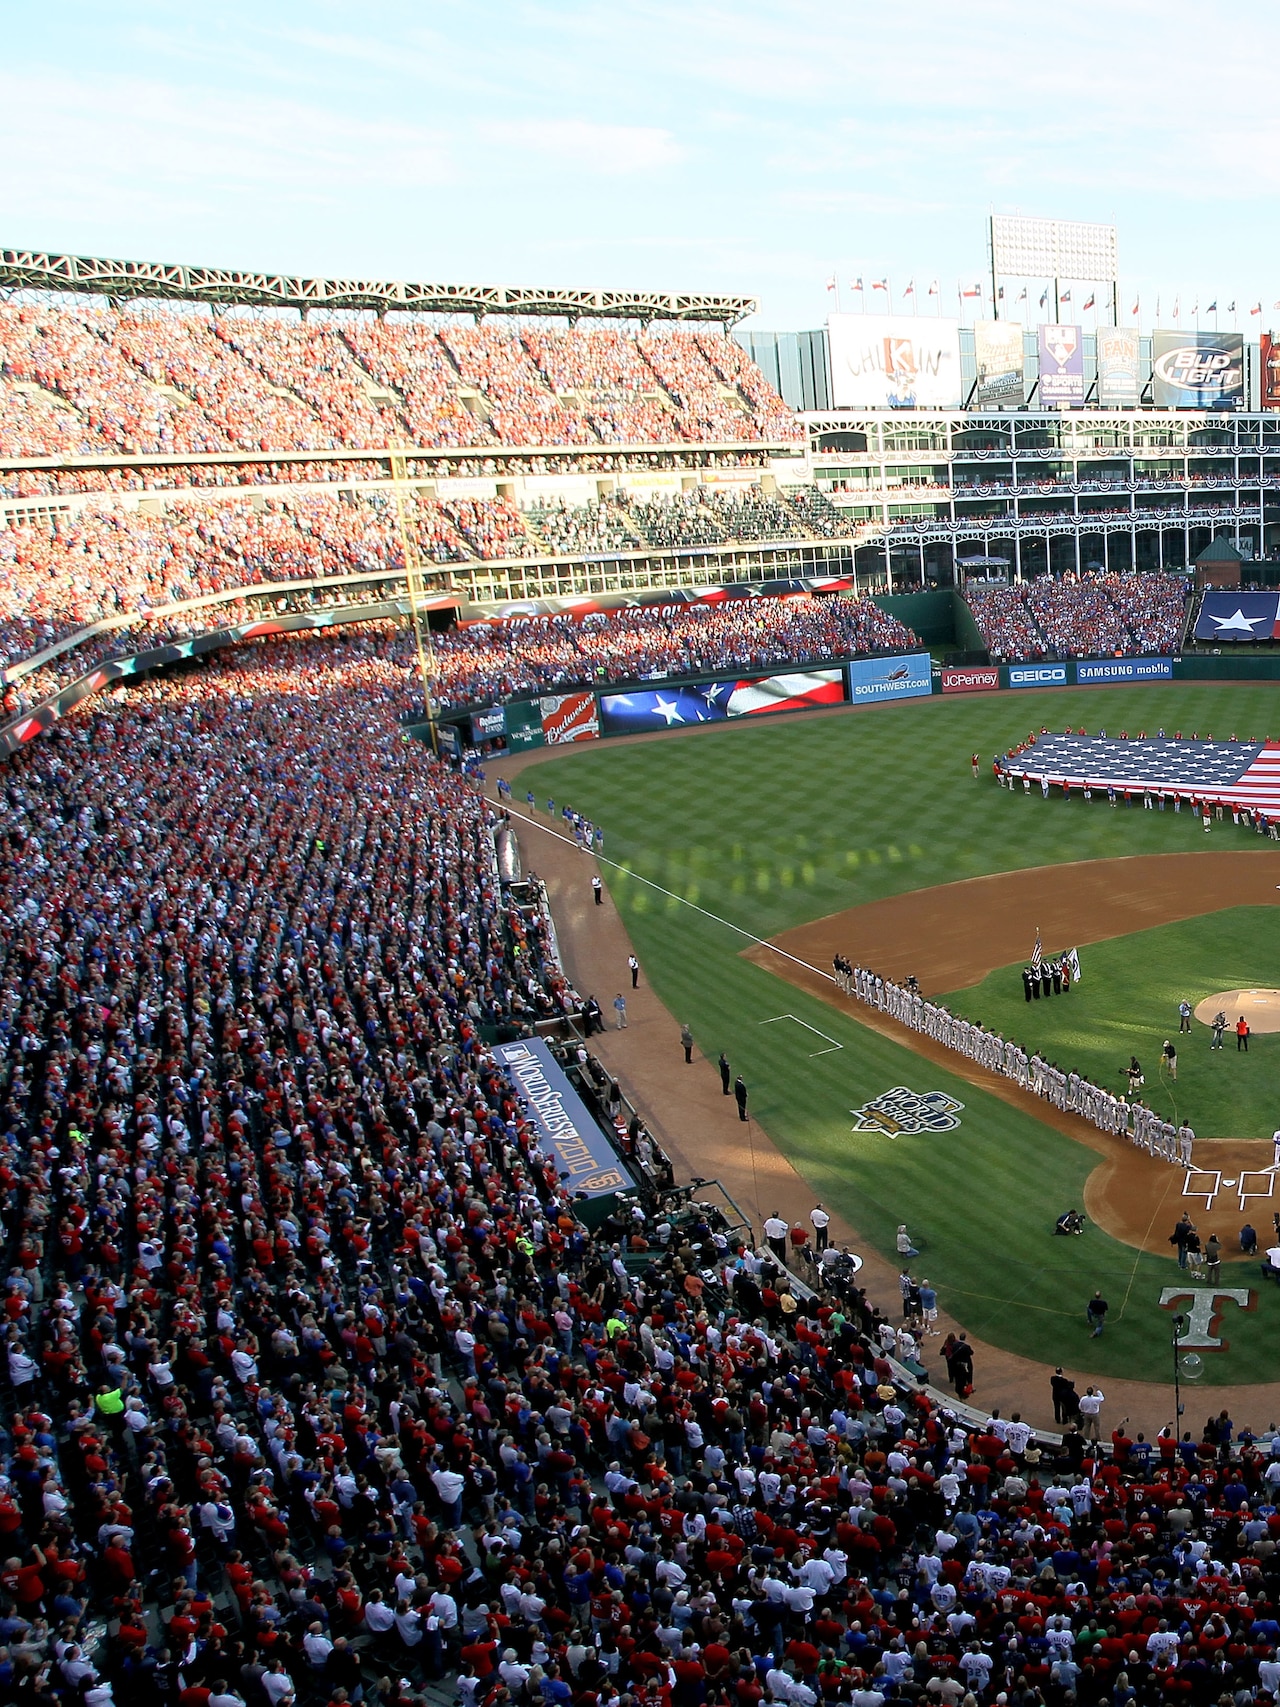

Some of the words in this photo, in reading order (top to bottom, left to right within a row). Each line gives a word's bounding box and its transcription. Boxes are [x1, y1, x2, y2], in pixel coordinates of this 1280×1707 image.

[1103, 340, 1135, 358] FAN
[1175, 352, 1231, 369] BUD
[1165, 366, 1240, 385] LIGHT
[943, 674, 997, 687] JCPenney
[1011, 669, 1066, 682] GEICO
[1080, 666, 1133, 677] SAMSUNG
[855, 680, 929, 695] SOUTHWEST.COM
[479, 714, 505, 727] Reliant
[546, 692, 595, 743] Budweiser
[872, 1101, 921, 1131] SERIES
[880, 1088, 955, 1129] WORLD
[555, 1138, 600, 1175] 2010
[1159, 1287, 1256, 1350] T
